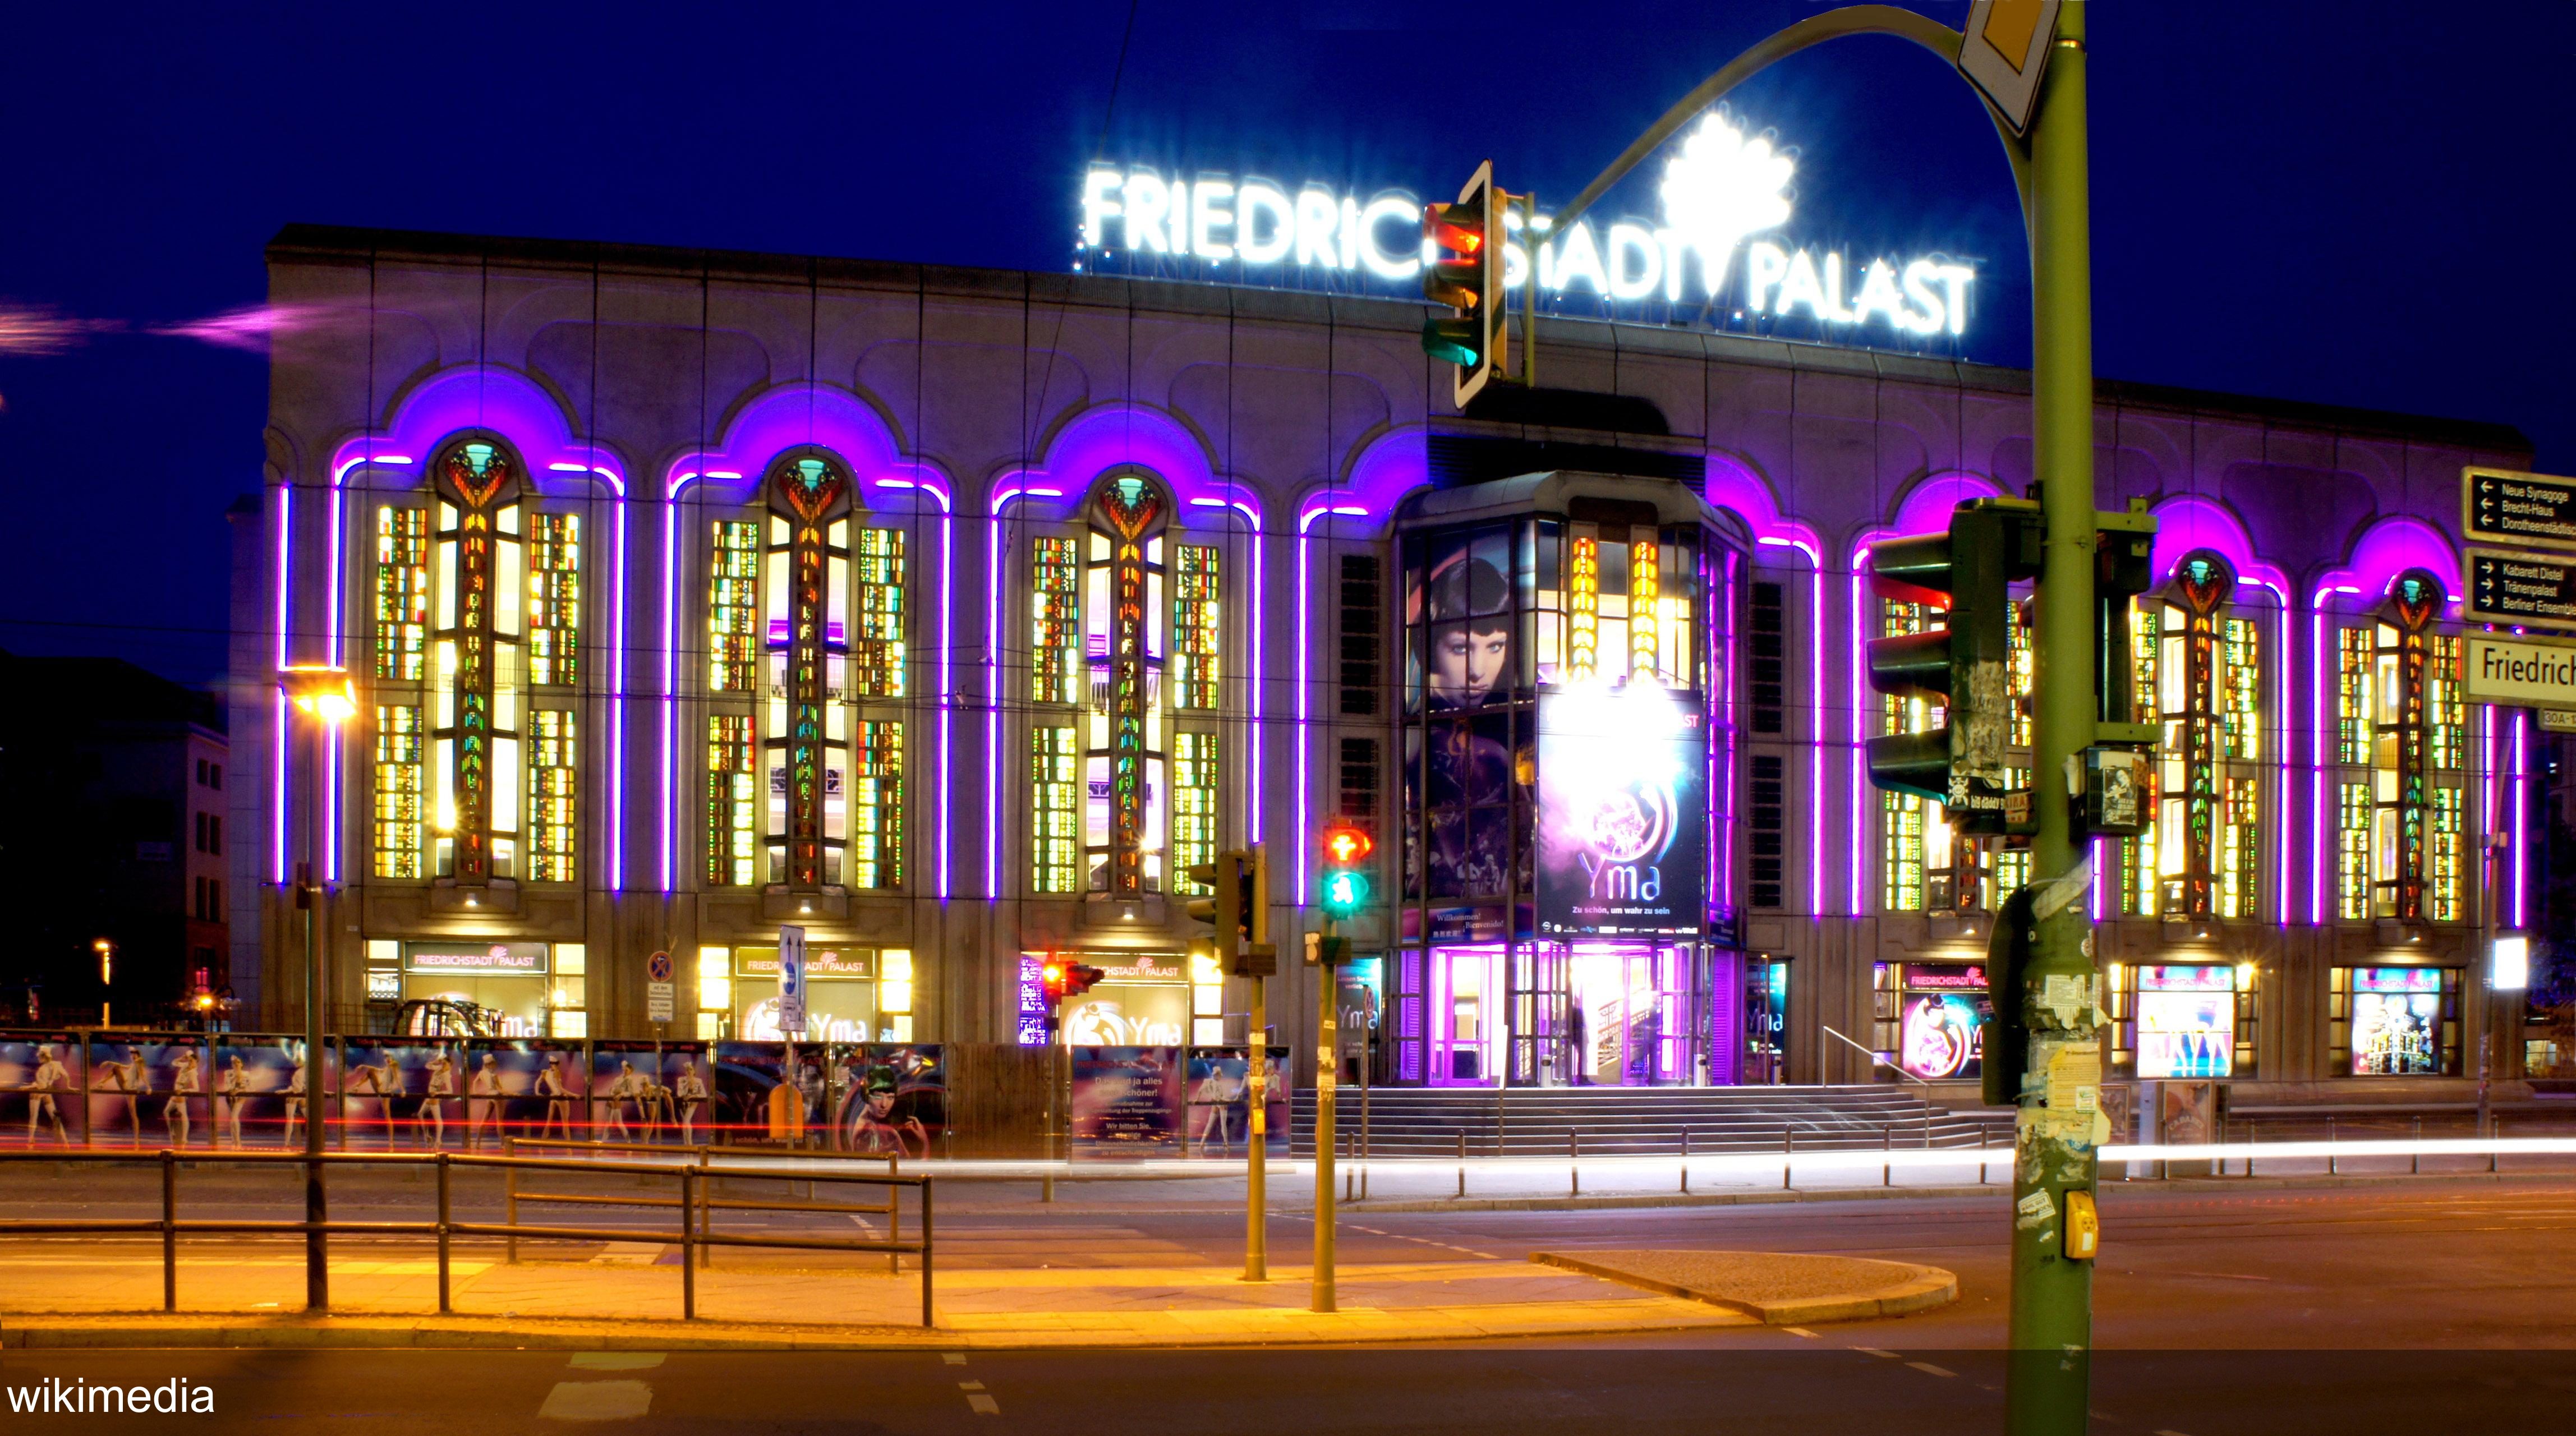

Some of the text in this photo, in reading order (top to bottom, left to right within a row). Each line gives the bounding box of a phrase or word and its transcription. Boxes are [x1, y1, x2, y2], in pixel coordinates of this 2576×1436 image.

[1750, 241, 1974, 335] PALAST
[2502, 484, 2568, 504] Neue Synagoge
[2502, 500, 2554, 517] Brecht-Haus
[2503, 563, 2564, 581] Kabarett Distel
[2503, 579, 2557, 597] Tränenpalast
[2503, 597, 2576, 615] Berliner Ensemble
[1577, 852, 1660, 901] Yma
[1437, 913, 1481, 922] Willkommen!
[1584, 906, 1609, 915] schön,
[1624, 906, 1643, 915] wahr
[415, 955, 535, 966] FRIEDRICHSTADT PALAST
[747, 960, 864, 972] FRIEDRADT PALAST
[1146, 966, 1179, 977] PALAST
[1911, 976, 1989, 986] FRIEDRICHSTADT PAL
[811, 1013, 866, 1043] Yma
[1129, 1016, 1181, 1046] Yma
[1133, 1078, 1141, 1086] ja
